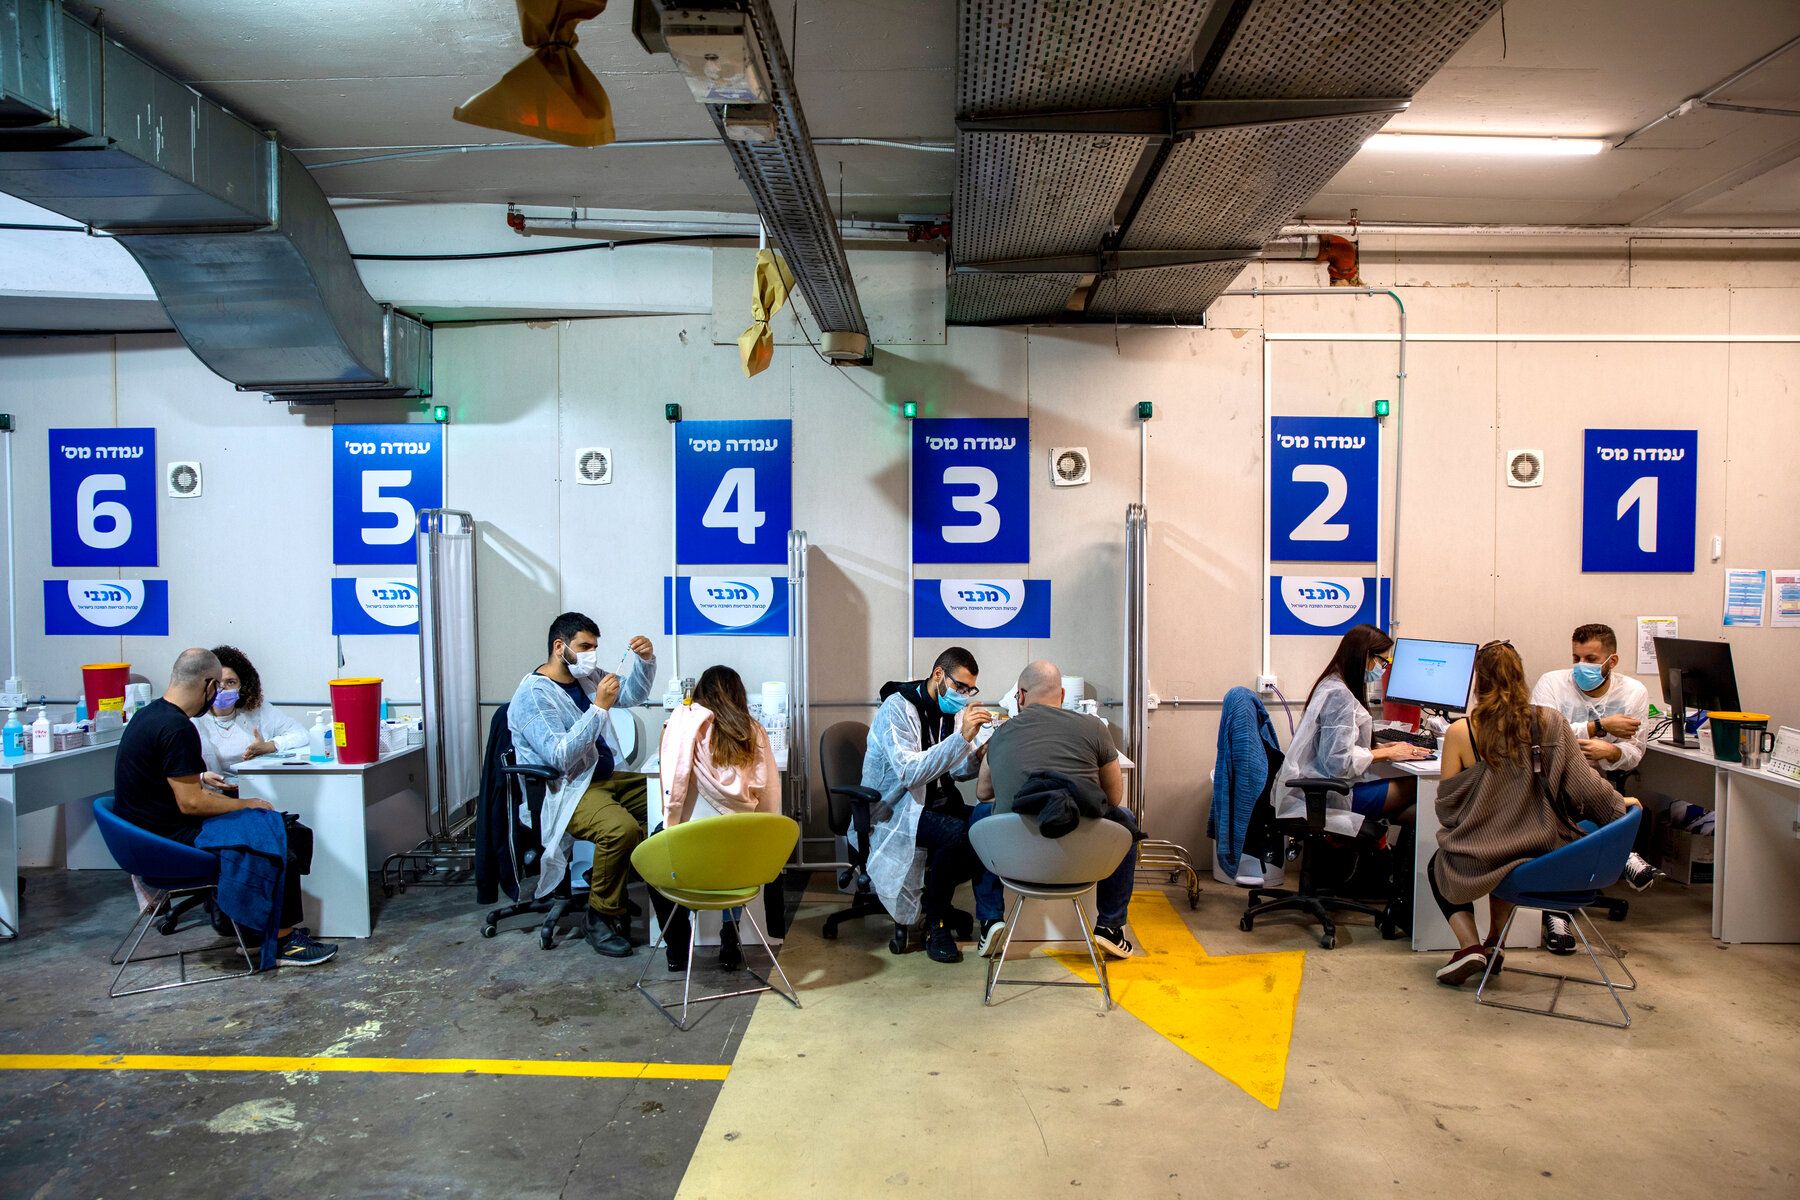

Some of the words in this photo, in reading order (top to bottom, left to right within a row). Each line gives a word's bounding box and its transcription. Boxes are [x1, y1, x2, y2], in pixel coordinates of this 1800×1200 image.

[345, 441, 377, 455] מס'
[381, 441, 431, 455] עמדה
[689, 438, 721, 452] מס'
[726, 439, 778, 452] עמדה
[925, 436, 959, 450] מס'
[963, 437, 1016, 450] עמדה
[1277, 434, 1309, 449] מס'
[1314, 435, 1366, 449] עמדה
[61, 446, 91, 459] מס'
[96, 446, 144, 459] עמדה
[1596, 446, 1629, 461] מס'
[1634, 448, 1685, 461] עמדה
[361, 470, 416, 545] 5
[702, 467, 766, 544] 4
[941, 466, 1001, 543] 3
[1289, 464, 1350, 541] 2
[77, 474, 132, 549] 6
[1617, 476, 1659, 553] 1
[83, 590, 122, 602] מכבי
[371, 589, 411, 601] מכבי
[706, 588, 749, 600] מכבי
[957, 590, 999, 602] מכבי
[1298, 588, 1339, 600] מכבי
